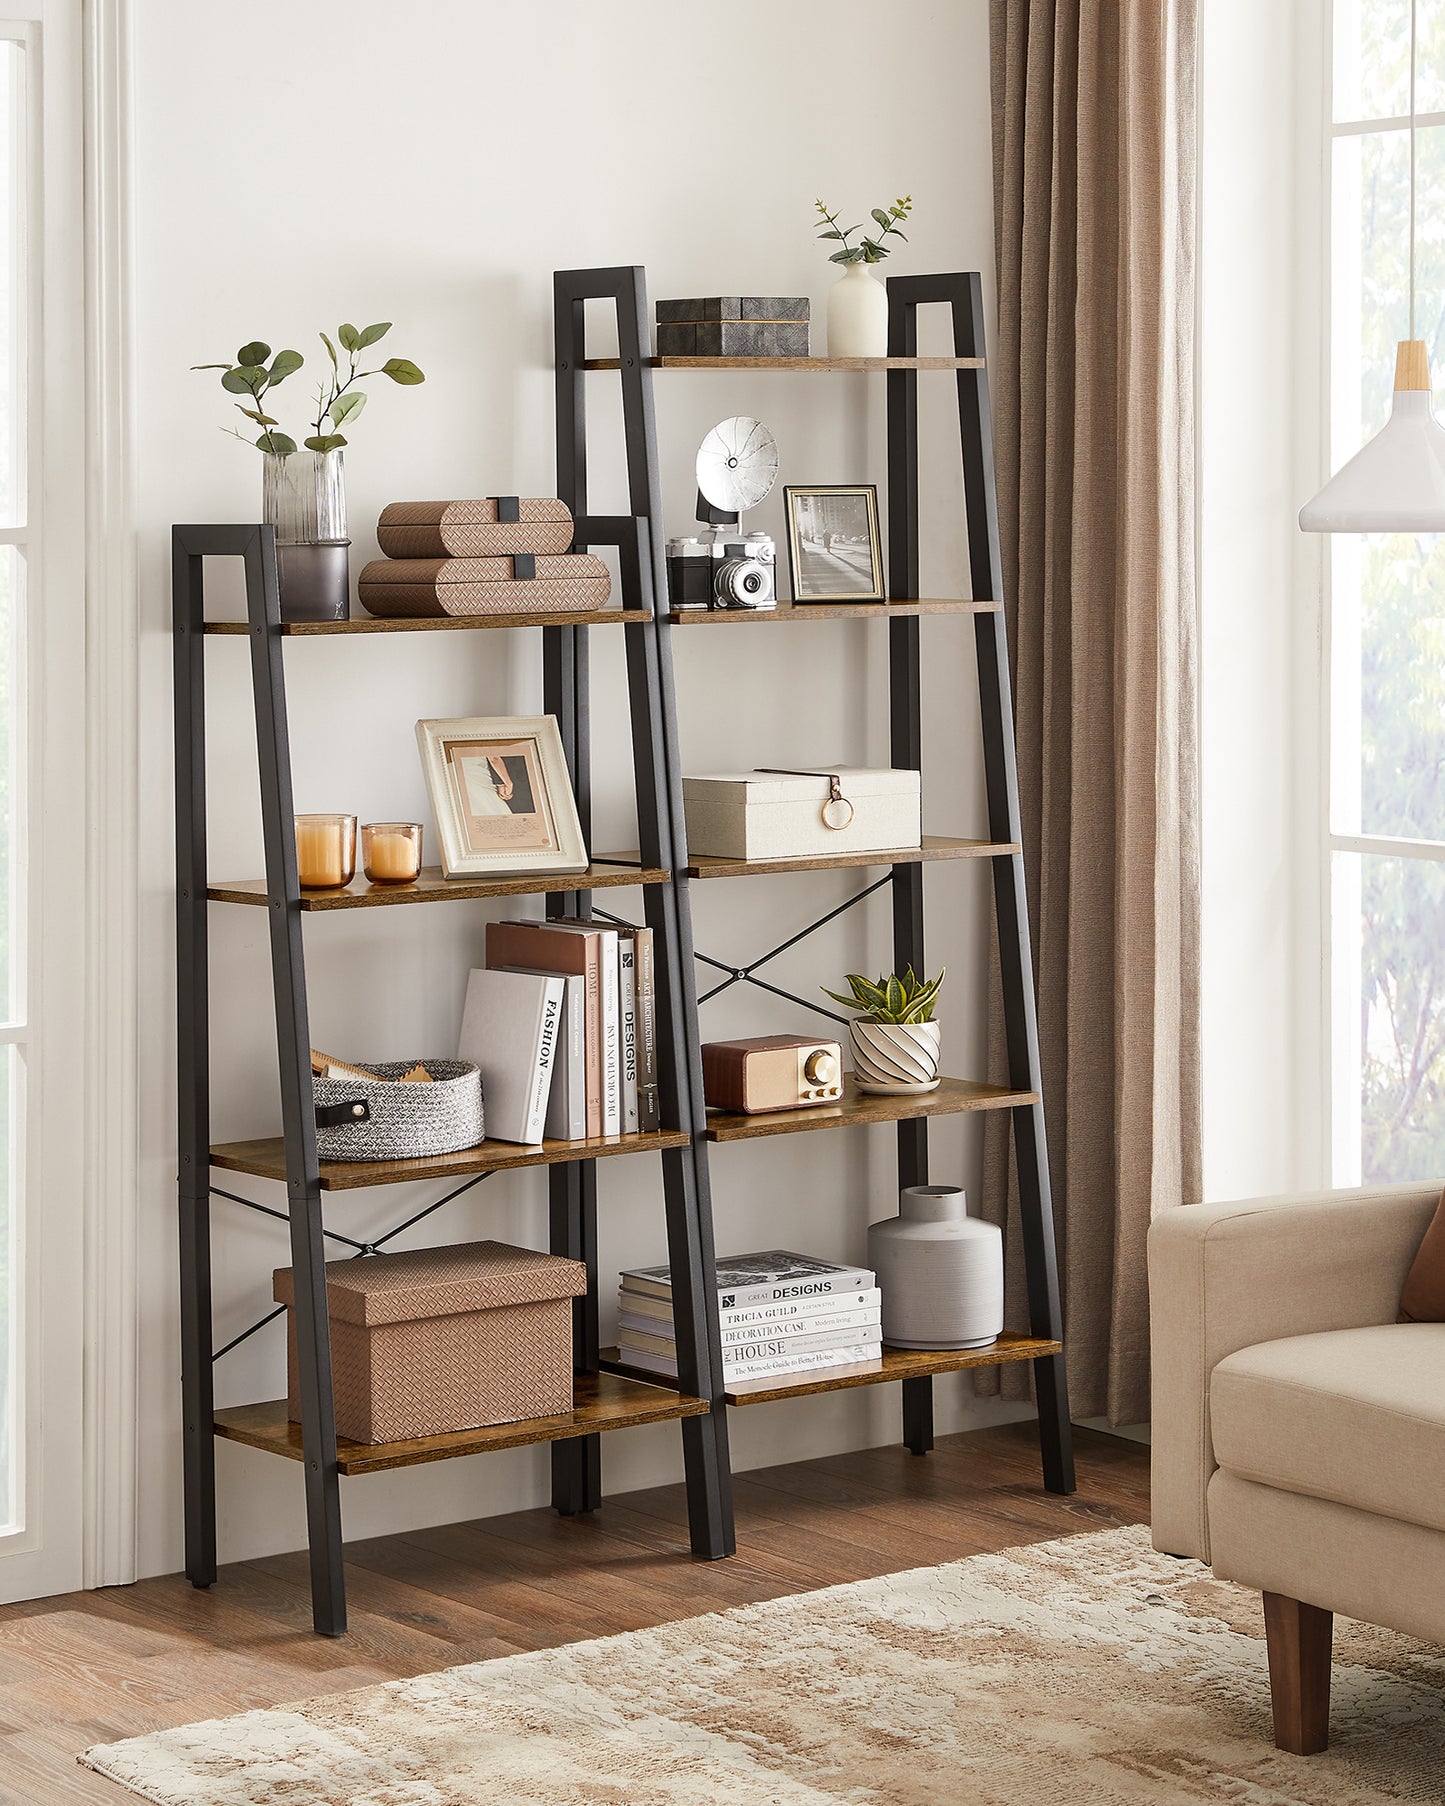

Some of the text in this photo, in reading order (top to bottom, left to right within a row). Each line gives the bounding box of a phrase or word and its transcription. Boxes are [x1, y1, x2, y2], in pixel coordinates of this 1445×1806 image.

[588, 962, 597, 998] HOME
[539, 1000, 557, 1068] FASHION
[607, 1021, 615, 1048] CASE
[644, 1001, 652, 1052] ARCHITECTURE
[625, 1012, 636, 1082] DESIGNS
[608, 1050, 616, 1117] DECORATION
[748, 1282, 832, 1302] GREAT DESIGNS
[726, 1312, 763, 1324] TRICIA
[766, 1306, 798, 1318] GUILD
[725, 1325, 783, 1342] DECORATION
[784, 1322, 807, 1333] CASE
[734, 1340, 786, 1360] HOUSE
[735, 1367, 746, 1376] The
[772, 1359, 790, 1369] Guide
[798, 1356, 815, 1364] Better
